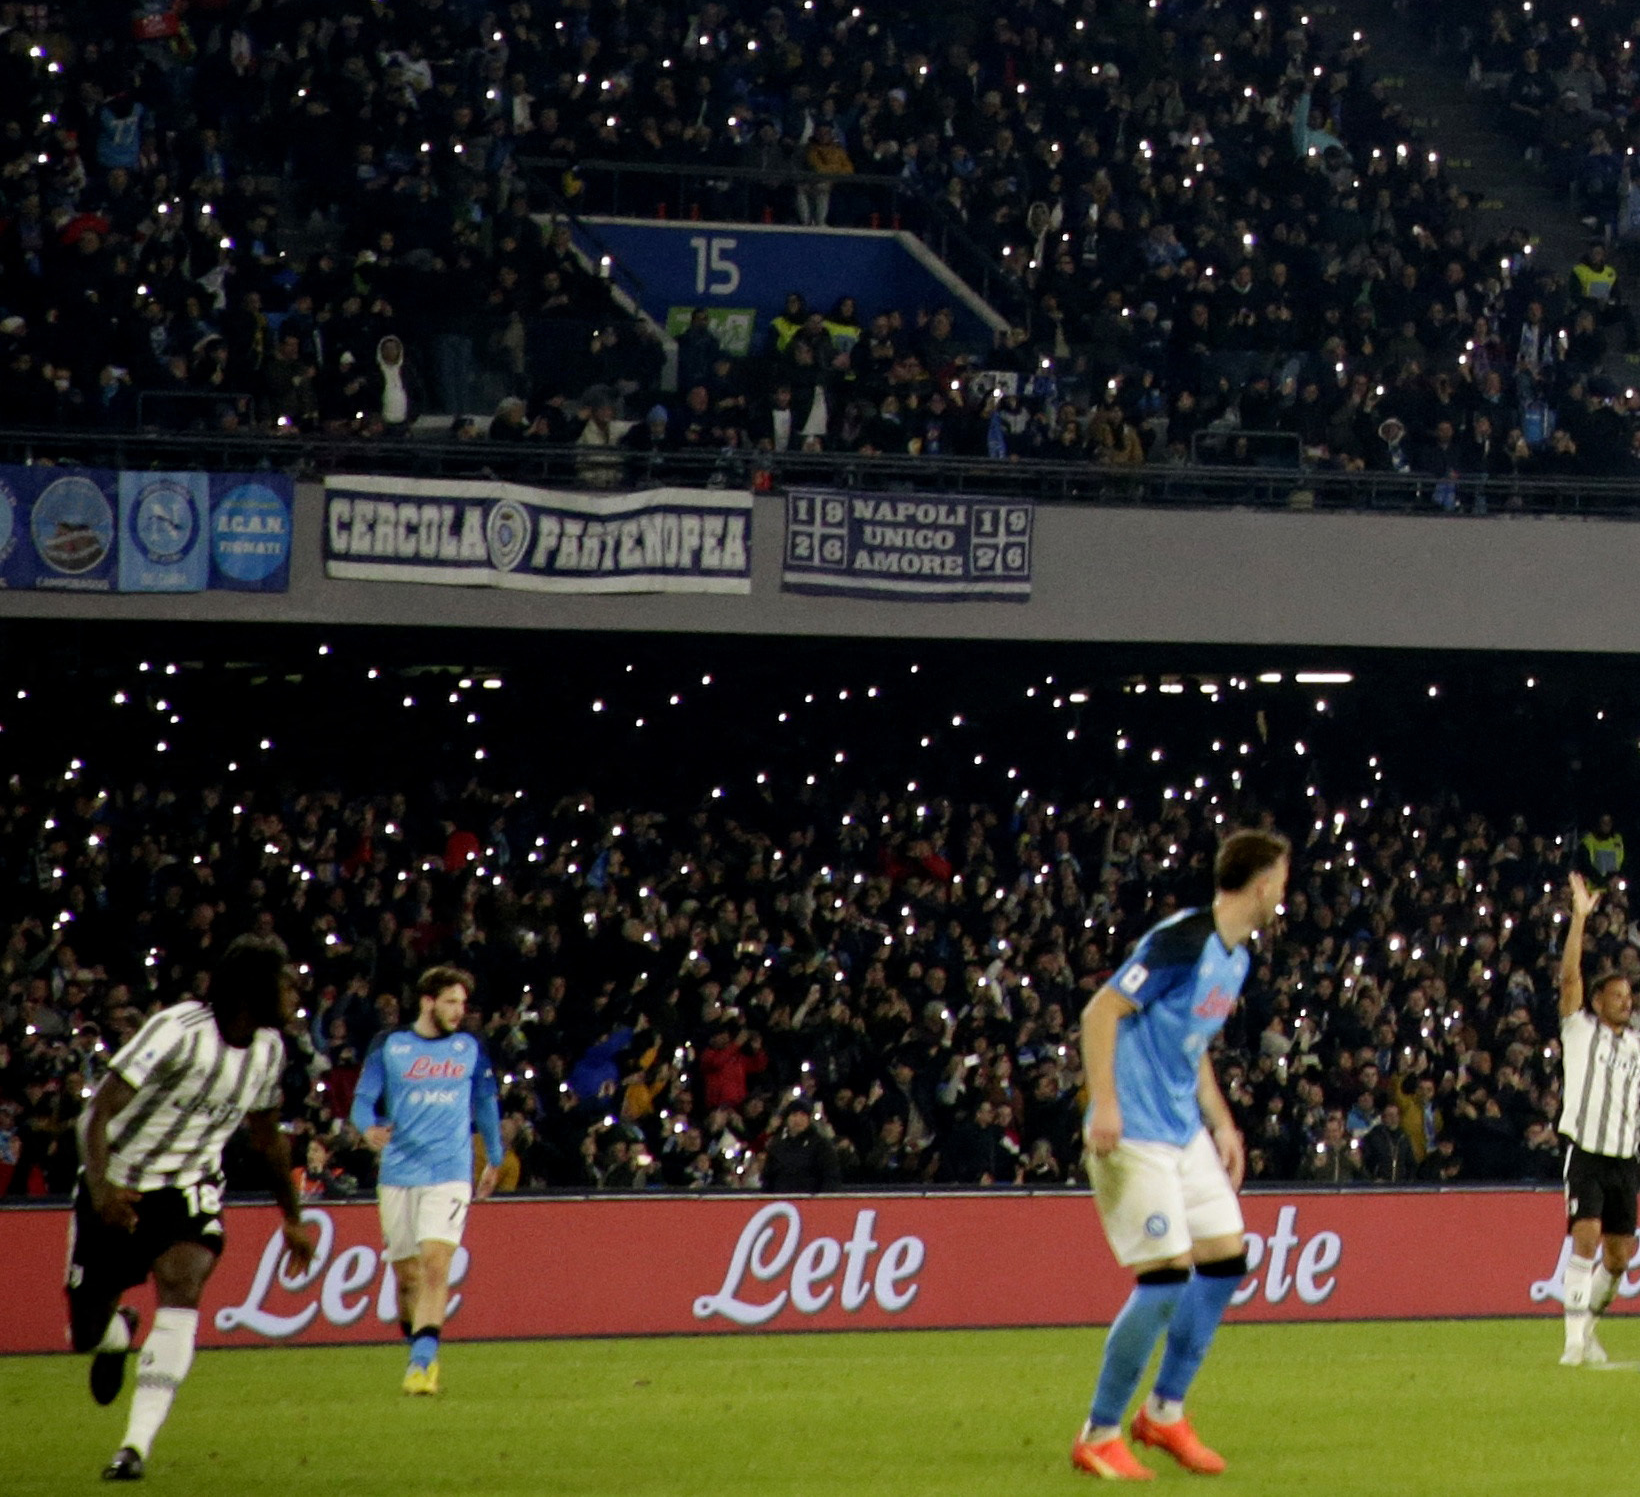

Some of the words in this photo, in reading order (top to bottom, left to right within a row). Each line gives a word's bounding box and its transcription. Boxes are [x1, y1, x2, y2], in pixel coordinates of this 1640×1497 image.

[689, 236, 742, 296] 15
[852, 498, 968, 527] NAPOLI
[328, 497, 489, 562] CERCOLA
[862, 525, 957, 551] UNICO
[853, 549, 965, 577] AMORE
[403, 1054, 467, 1082] Lete
[692, 1201, 926, 1326] Lete
